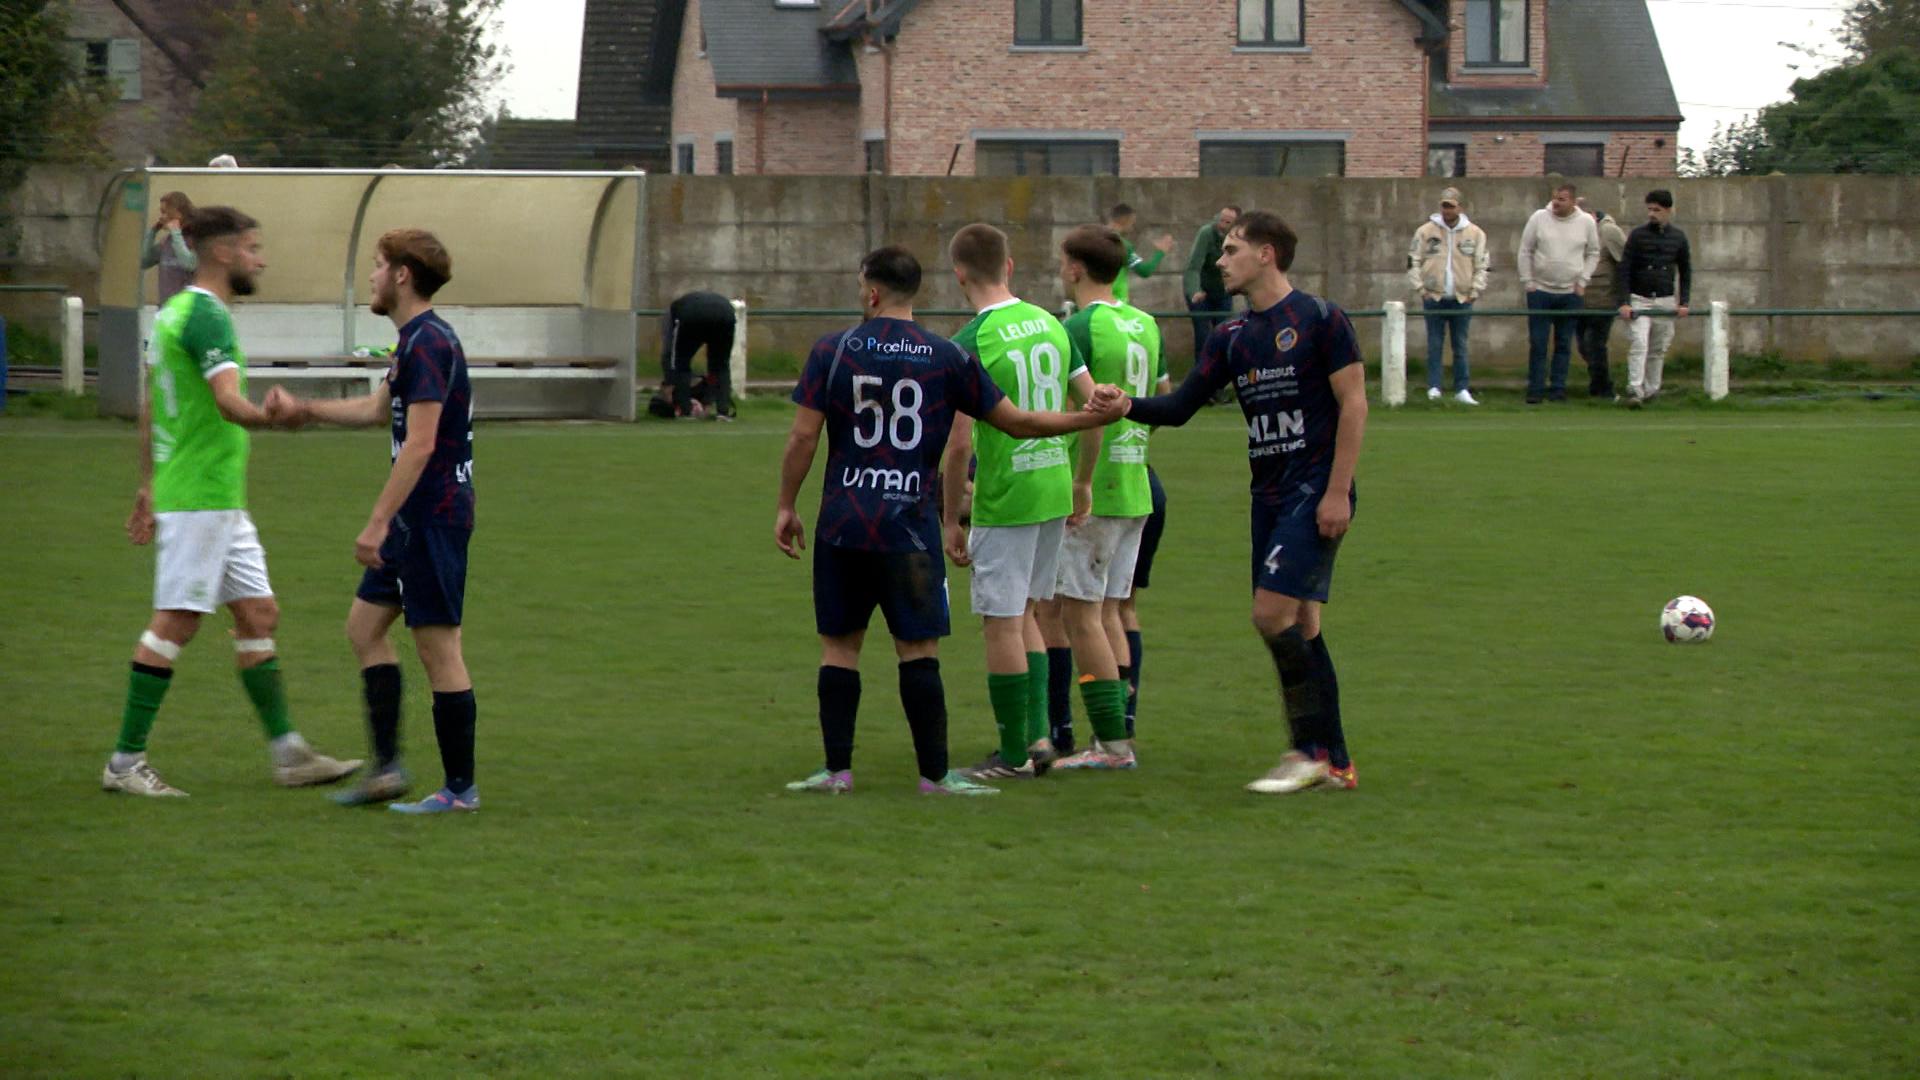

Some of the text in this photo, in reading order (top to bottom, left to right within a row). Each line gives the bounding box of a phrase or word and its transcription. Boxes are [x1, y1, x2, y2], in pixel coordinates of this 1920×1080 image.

[1006, 342, 1063, 413] 18
[1126, 342, 1149, 398] 9
[852, 375, 923, 451] 58
[1264, 545, 1284, 574] 4
